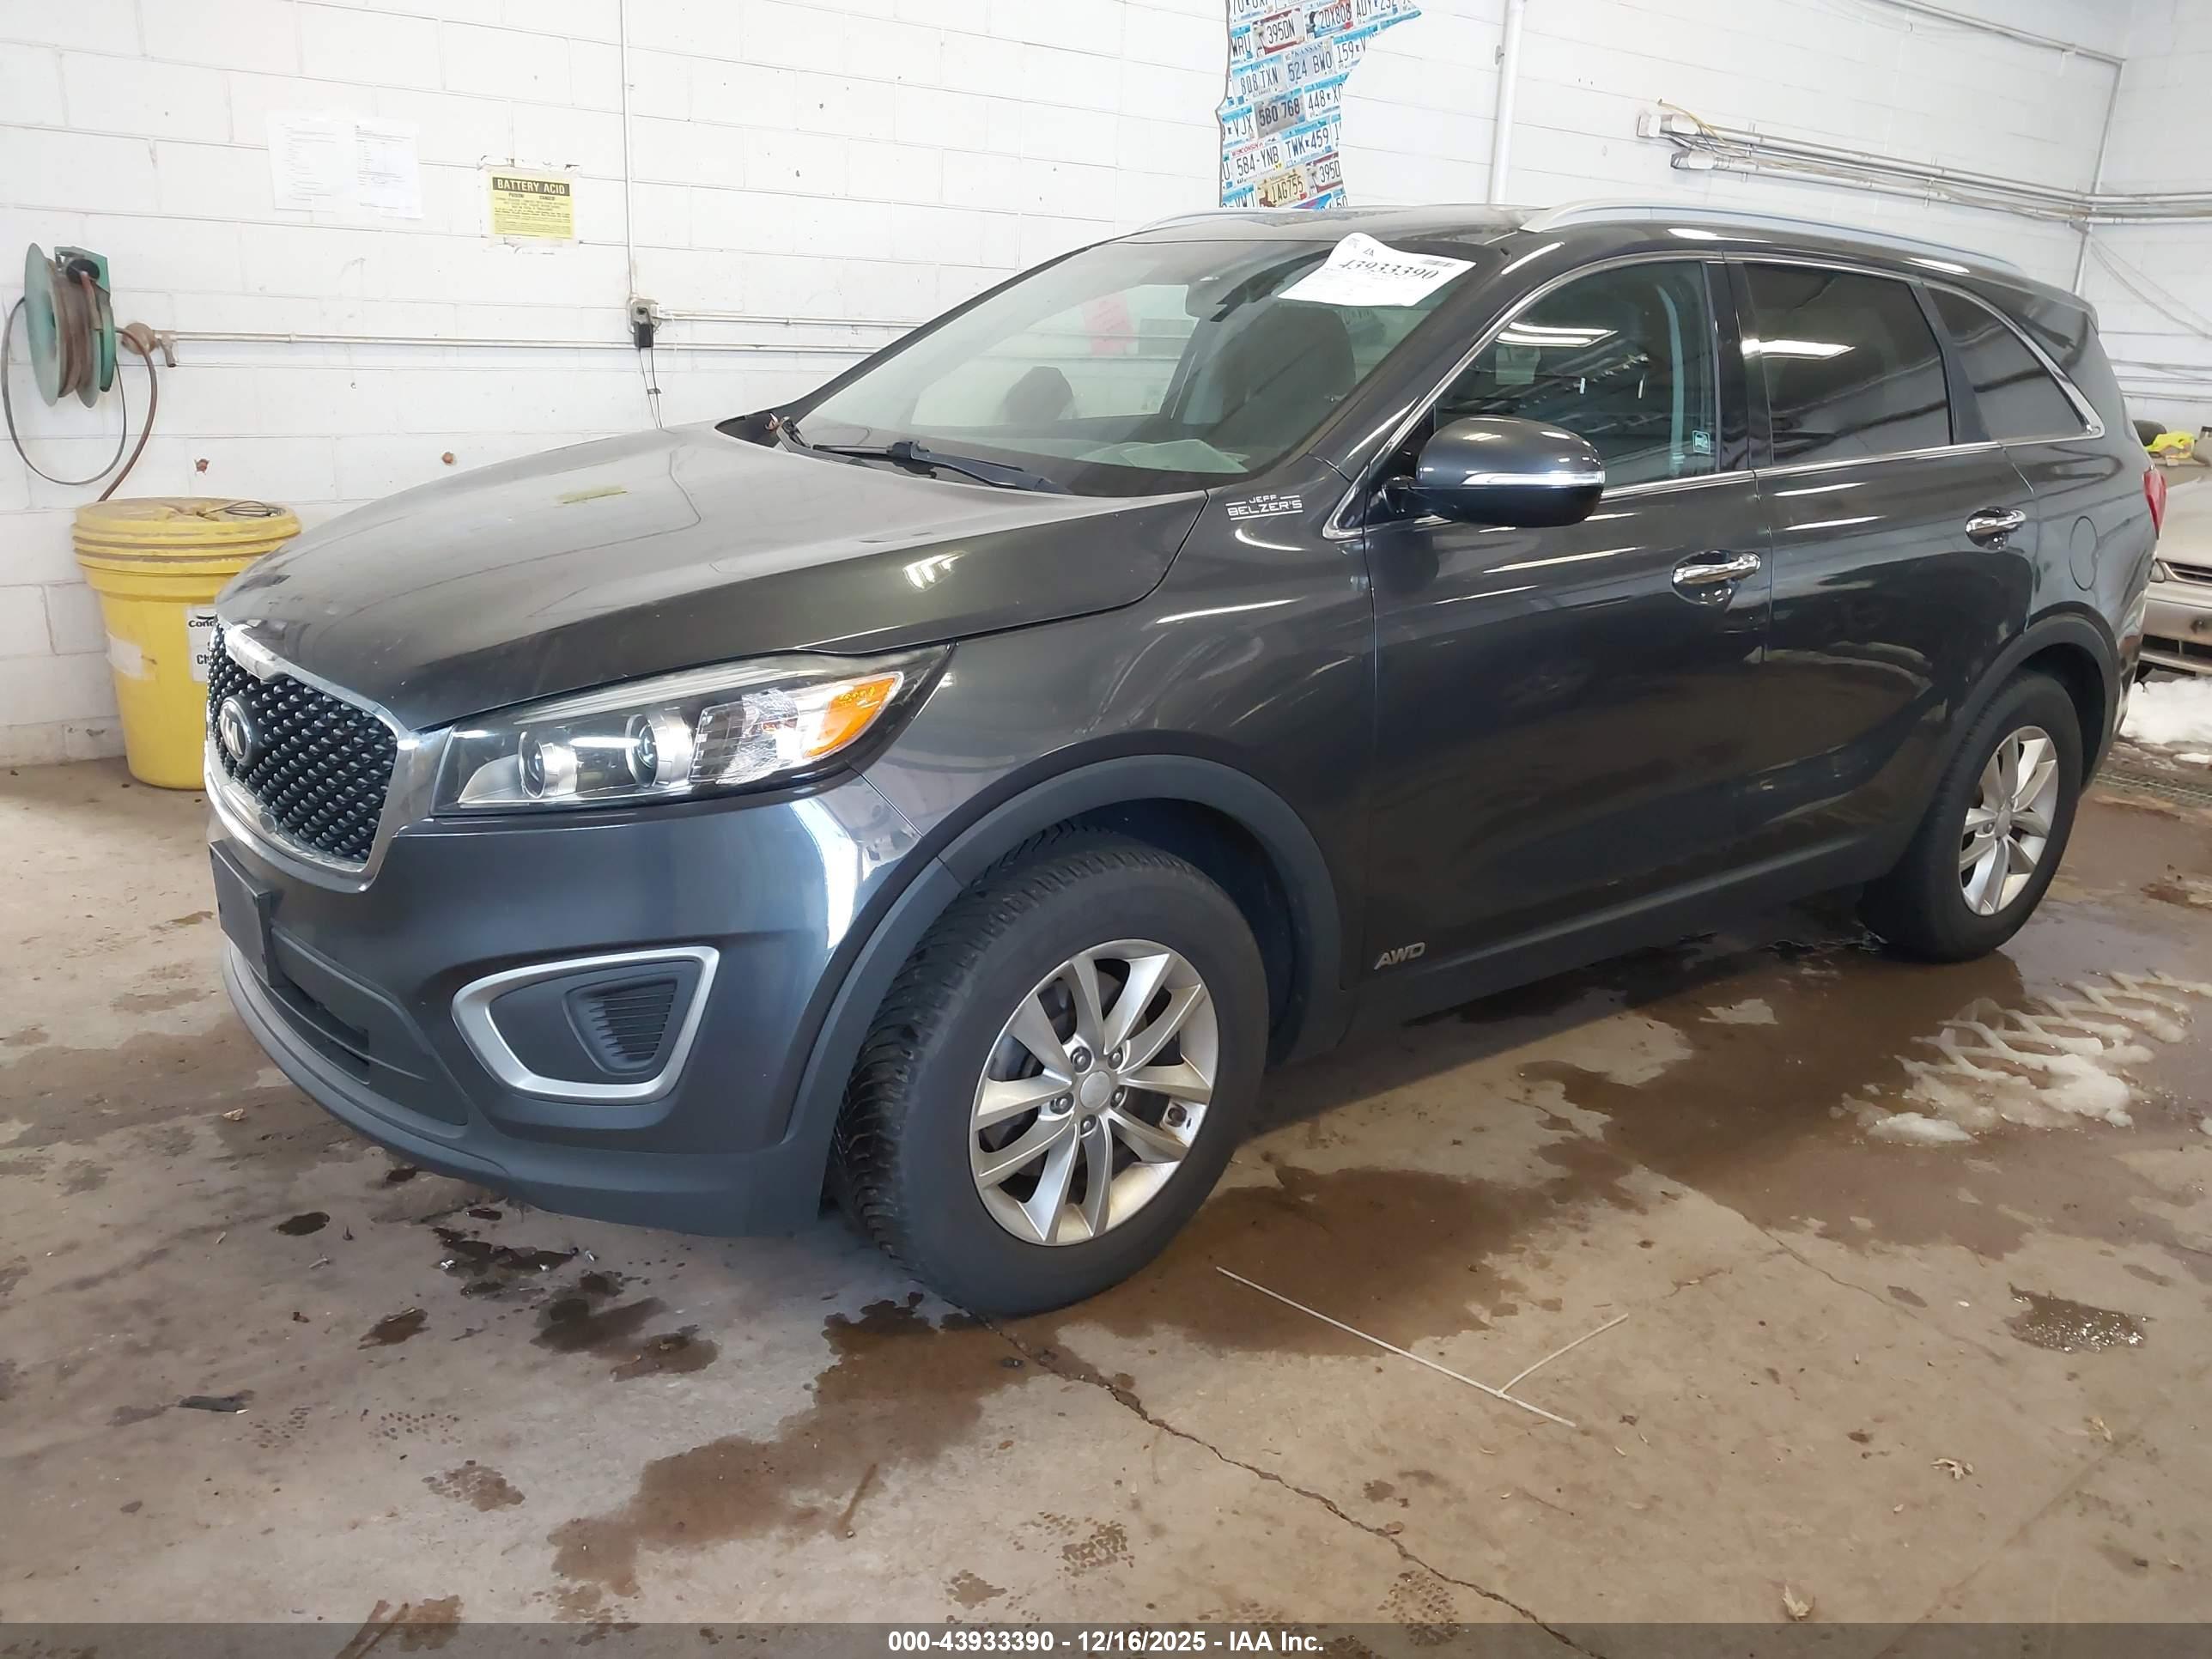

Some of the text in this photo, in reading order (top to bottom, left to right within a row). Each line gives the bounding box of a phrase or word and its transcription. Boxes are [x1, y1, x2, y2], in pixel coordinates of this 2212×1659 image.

[1240, 66, 1279, 95] 808 TXN
[1287, 59, 1308, 82] 524
[1280, 97, 1301, 118] 768
[1236, 145, 1280, 177] 584-YNB
[497, 179, 565, 195] BATTERY ACID
[1227, 500, 1303, 516] BELZER'S
[1249, 495, 1277, 504] JEFF
[1374, 942, 1425, 970] AWD
